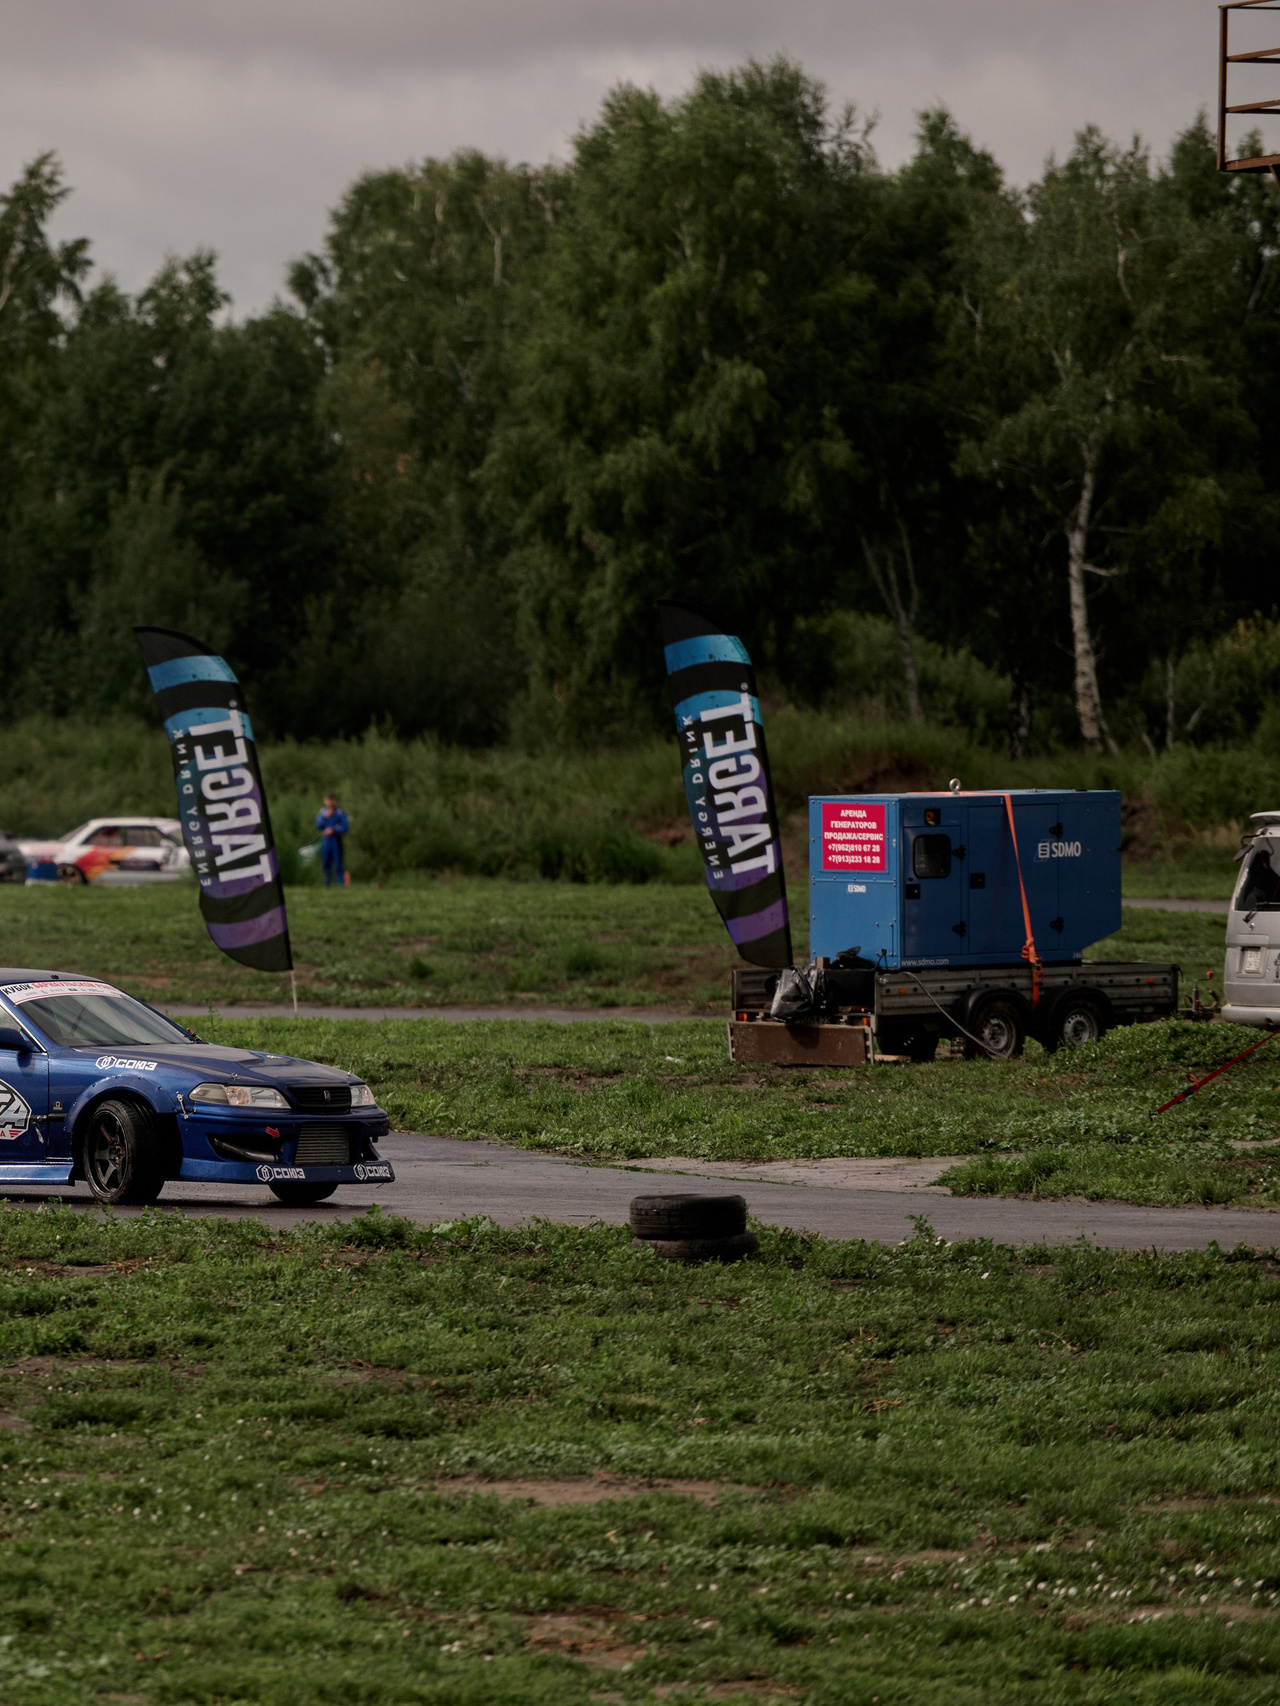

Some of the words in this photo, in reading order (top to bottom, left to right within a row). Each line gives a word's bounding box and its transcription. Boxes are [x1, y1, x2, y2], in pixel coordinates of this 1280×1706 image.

[840, 809, 867, 818] АРЕНДА
[830, 821, 877, 829] ГЕНЕРАТОРОВ
[824, 832, 884, 841] ПРОДАЖА/СЕРВИС
[863, 844, 871, 852] 67
[1051, 841, 1082, 858] SDMO
[900, 957, 950, 966] www.sdmo.com
[2, 983, 33, 995] КУБОК
[115, 1058, 158, 1071] СОЮЗ
[273, 1168, 306, 1179] СОЮЗ
[366, 1166, 391, 1177] СОЮЗ
